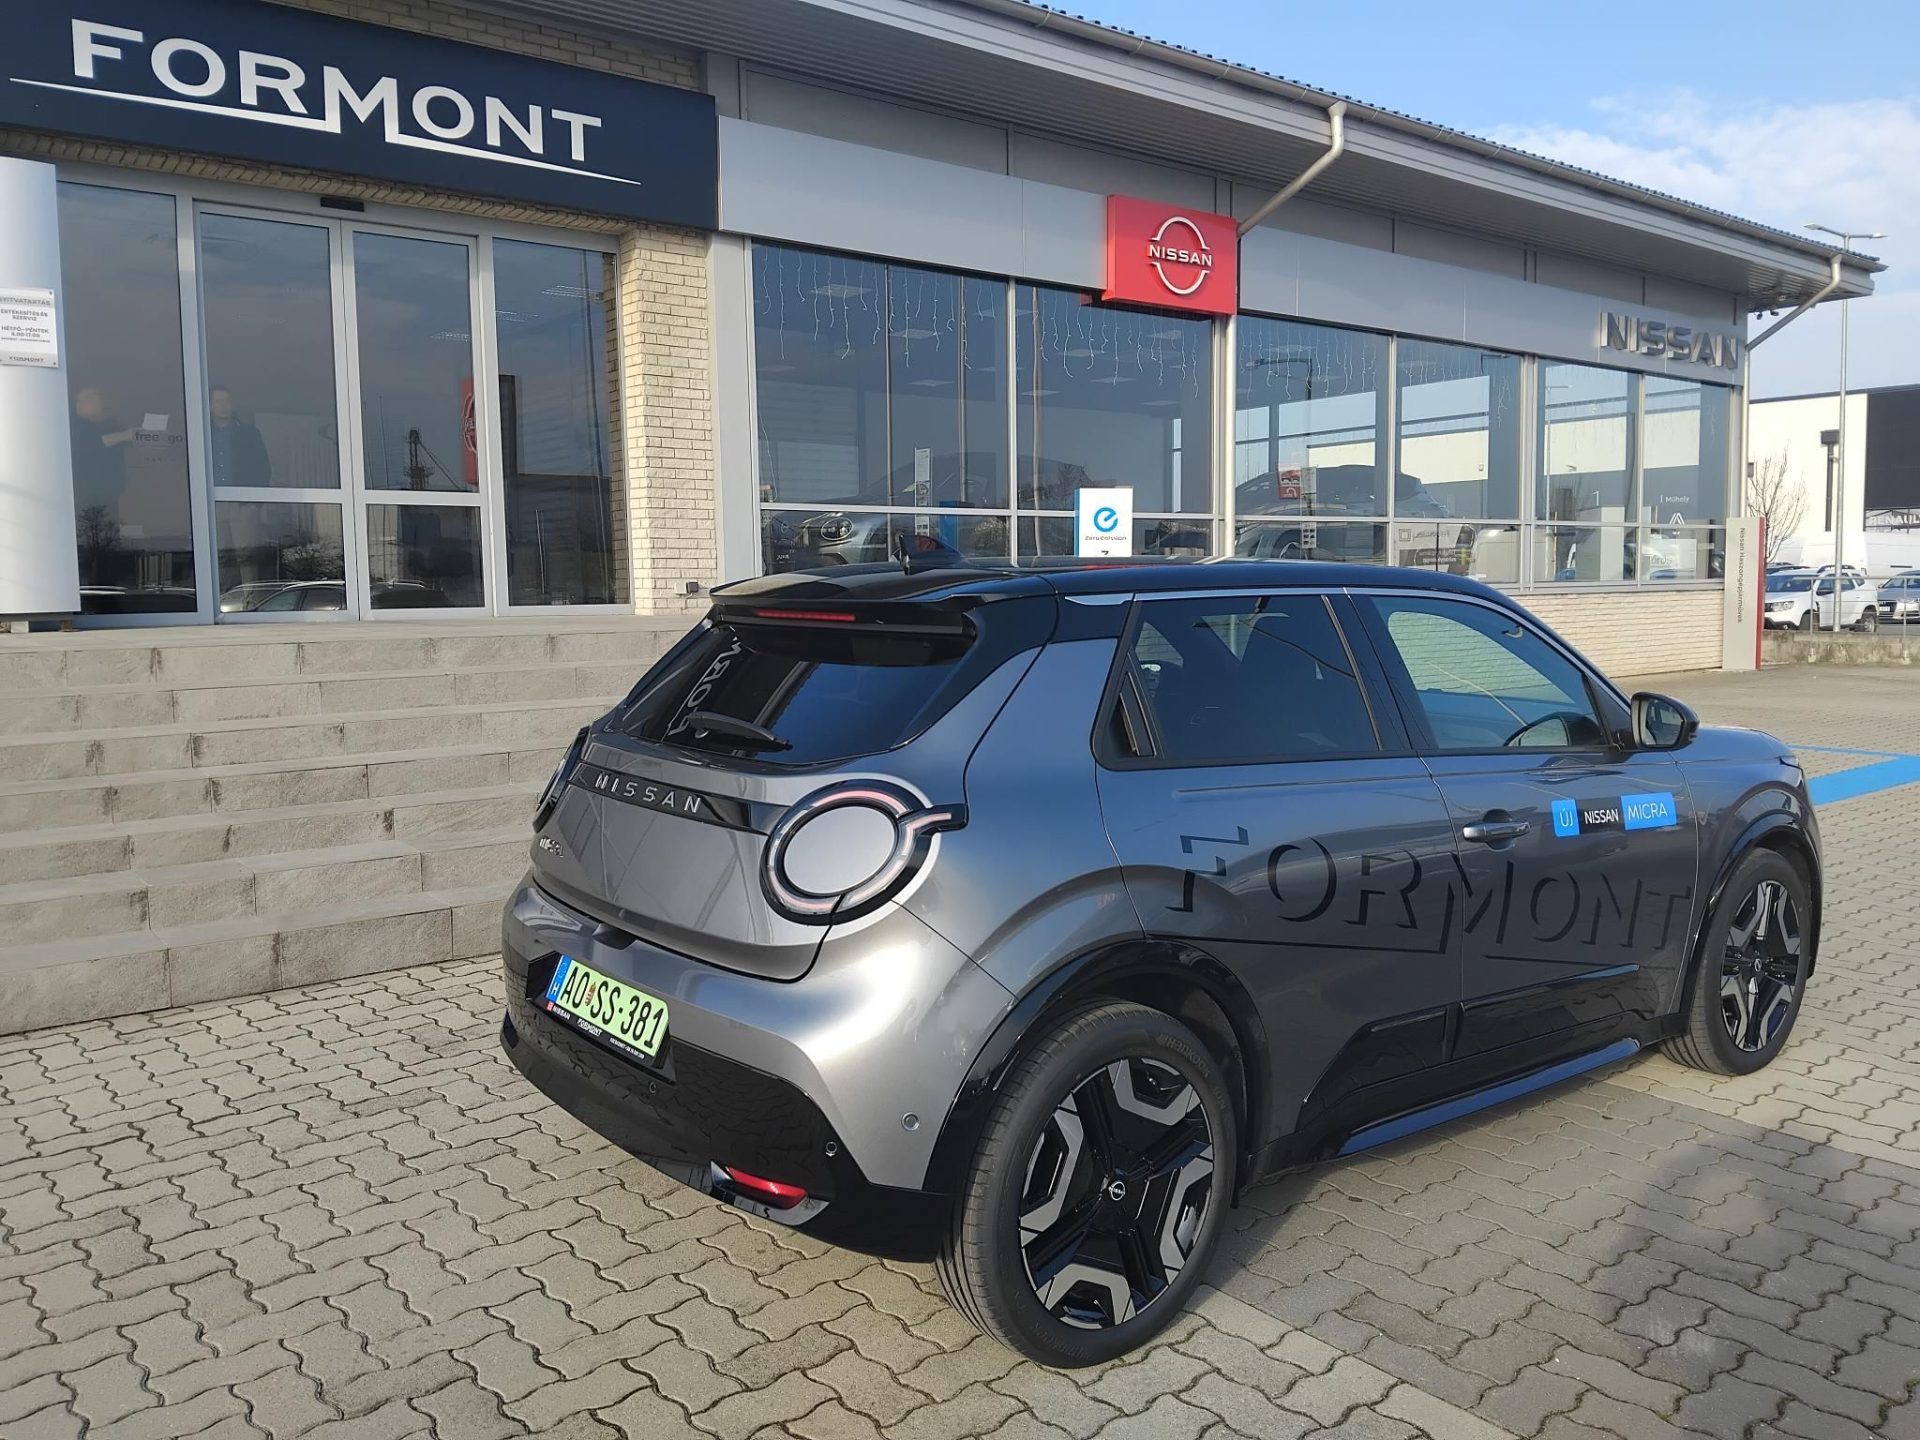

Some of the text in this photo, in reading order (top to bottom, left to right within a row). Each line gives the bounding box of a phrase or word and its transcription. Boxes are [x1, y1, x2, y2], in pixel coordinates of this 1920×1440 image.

[71, 18, 602, 162] FORMONT
[1149, 244, 1212, 267] NISSAN
[1600, 311, 1738, 370] NISSAN
[594, 772, 702, 814] NISSAN
[1584, 808, 1619, 825] NISSAN
[1627, 802, 1668, 821] MICRA
[1164, 826, 1693, 954] FORMONT
